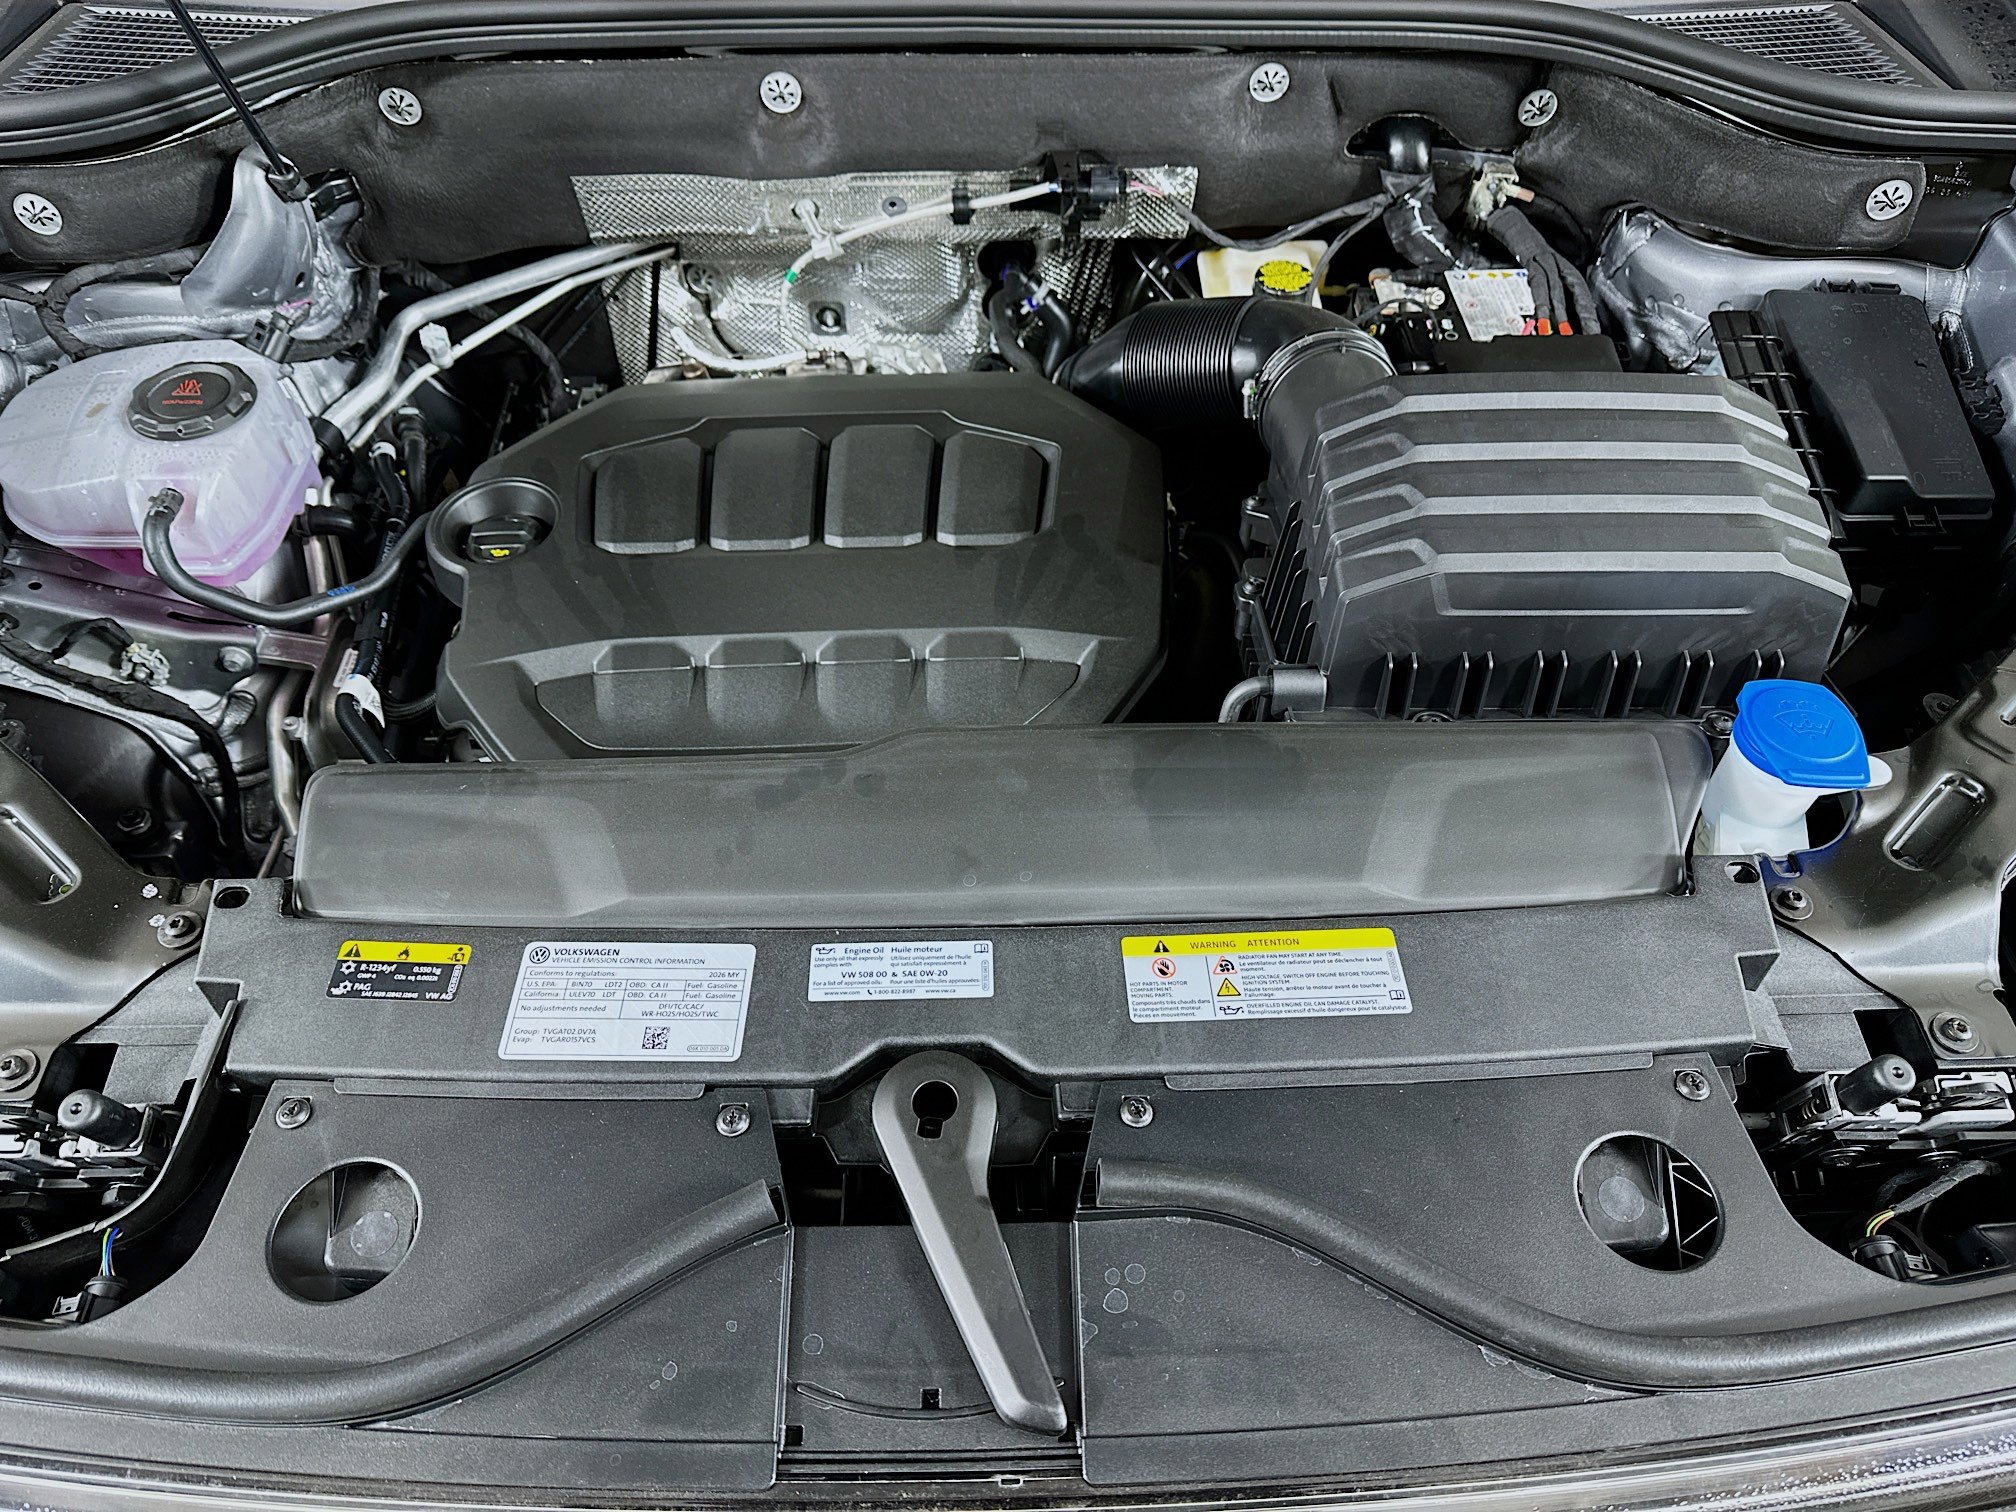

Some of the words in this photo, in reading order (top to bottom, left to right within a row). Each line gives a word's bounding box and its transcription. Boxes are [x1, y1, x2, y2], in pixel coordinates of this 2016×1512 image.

[1190, 941, 1236, 949] WARNING
[844, 947, 871, 955] Engine
[360, 964, 397, 974] R-1234yf
[432, 967, 442, 975] kg
